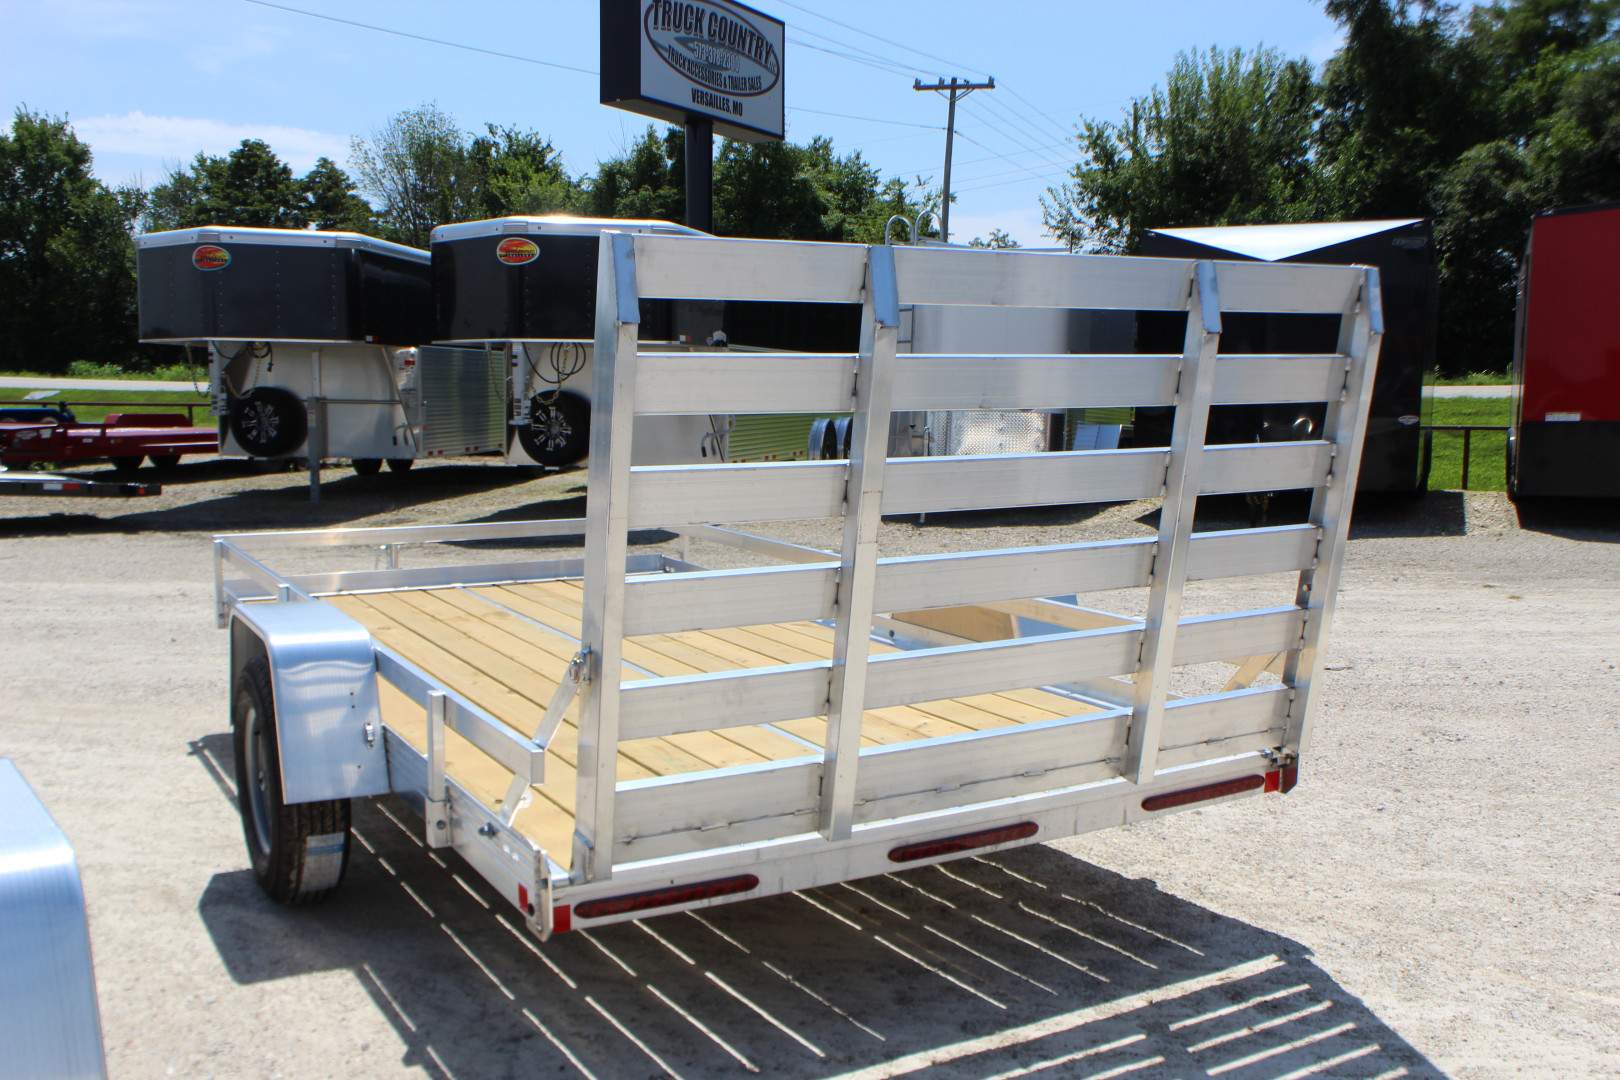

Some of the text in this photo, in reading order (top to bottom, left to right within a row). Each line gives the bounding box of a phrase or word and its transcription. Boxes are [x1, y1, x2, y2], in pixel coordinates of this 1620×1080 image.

[652, 0, 706, 38] TRUCK
[708, 12, 773, 65] COUNTRY
[668, 45, 761, 92] TRUCK ACCESSORIES & TRAILER SALES
[691, 87, 743, 117] VERSAILLES, MO
